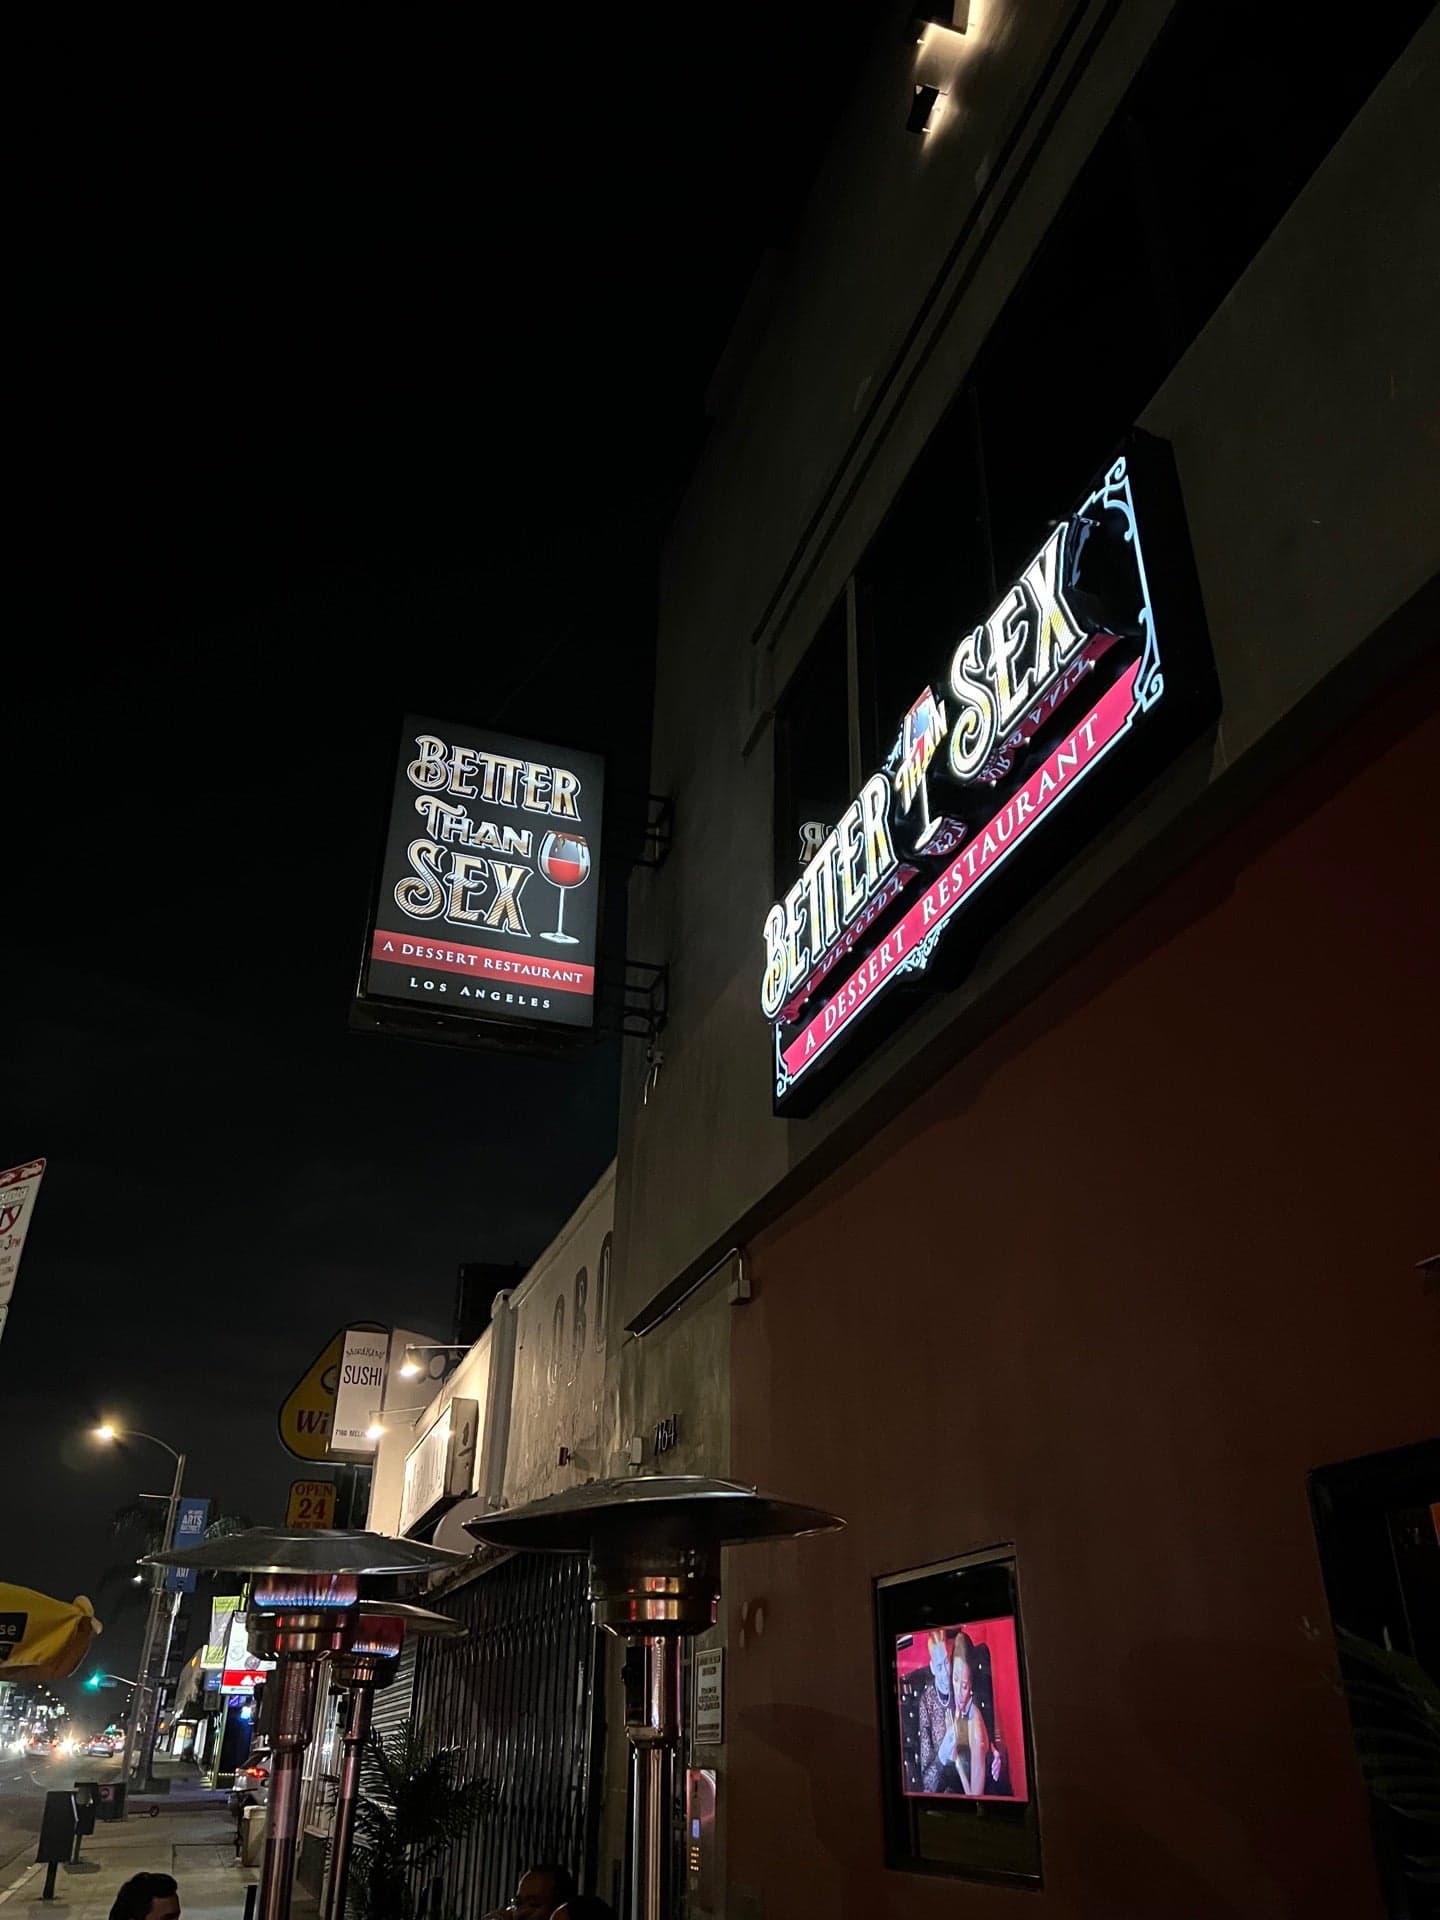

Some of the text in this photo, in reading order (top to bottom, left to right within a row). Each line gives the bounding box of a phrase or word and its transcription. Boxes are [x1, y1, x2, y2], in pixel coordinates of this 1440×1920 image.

[407, 734, 582, 822] BETTER
[761, 520, 1089, 1020] BETTER THAN SEX
[414, 794, 534, 857] THAN
[394, 838, 535, 938] SEX
[804, 712, 1101, 1054] A DESSERT RESTAURANT
[383, 941, 583, 984] A DESSERT RESTAURANT
[410, 977, 551, 1009] LOS ANGELES
[343, 1365, 383, 1386] SUSHI
[295, 1483, 333, 1497] OPEN
[298, 1498, 326, 1520] 24
[182, 1514, 204, 1528] ARTS
